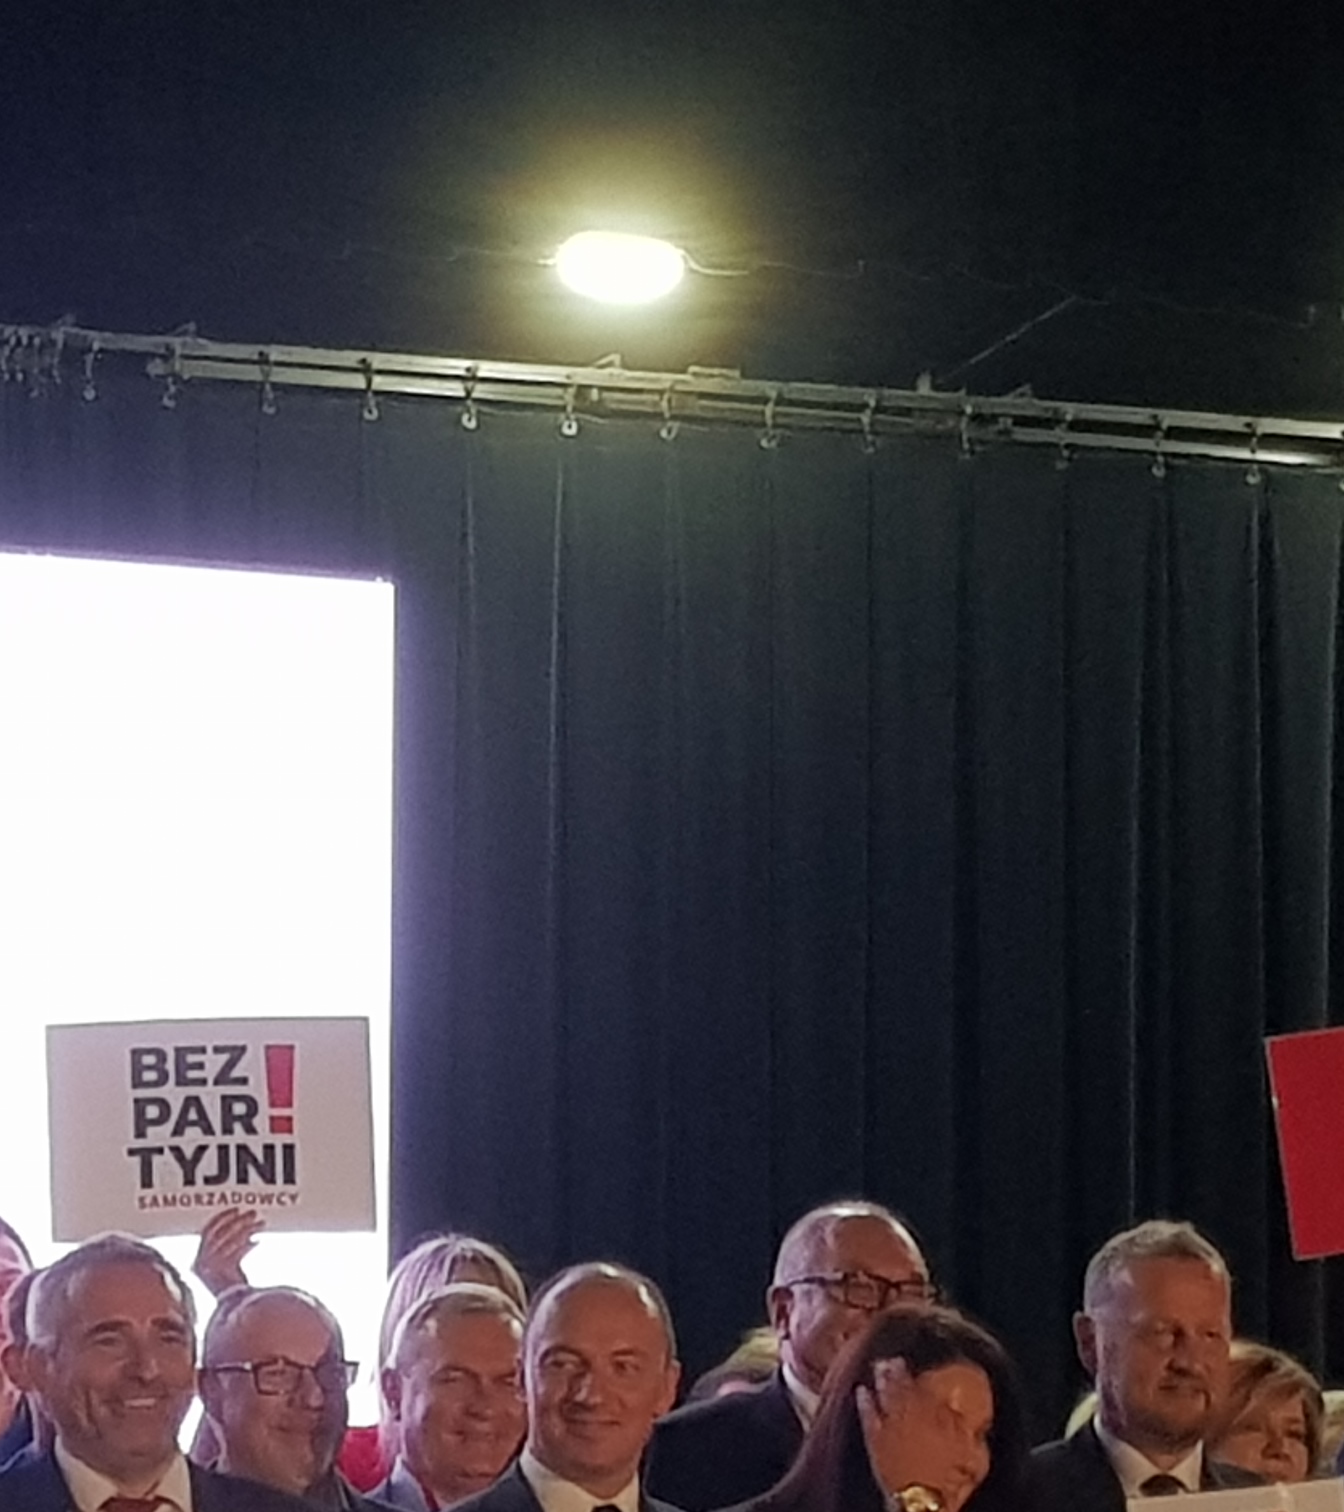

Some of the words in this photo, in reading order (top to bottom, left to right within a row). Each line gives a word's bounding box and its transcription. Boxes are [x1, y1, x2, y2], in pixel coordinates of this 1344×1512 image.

[130, 1045, 250, 1090] BEZ
[131, 1096, 260, 1140] PAR
[127, 1142, 297, 1190] TYJNI
